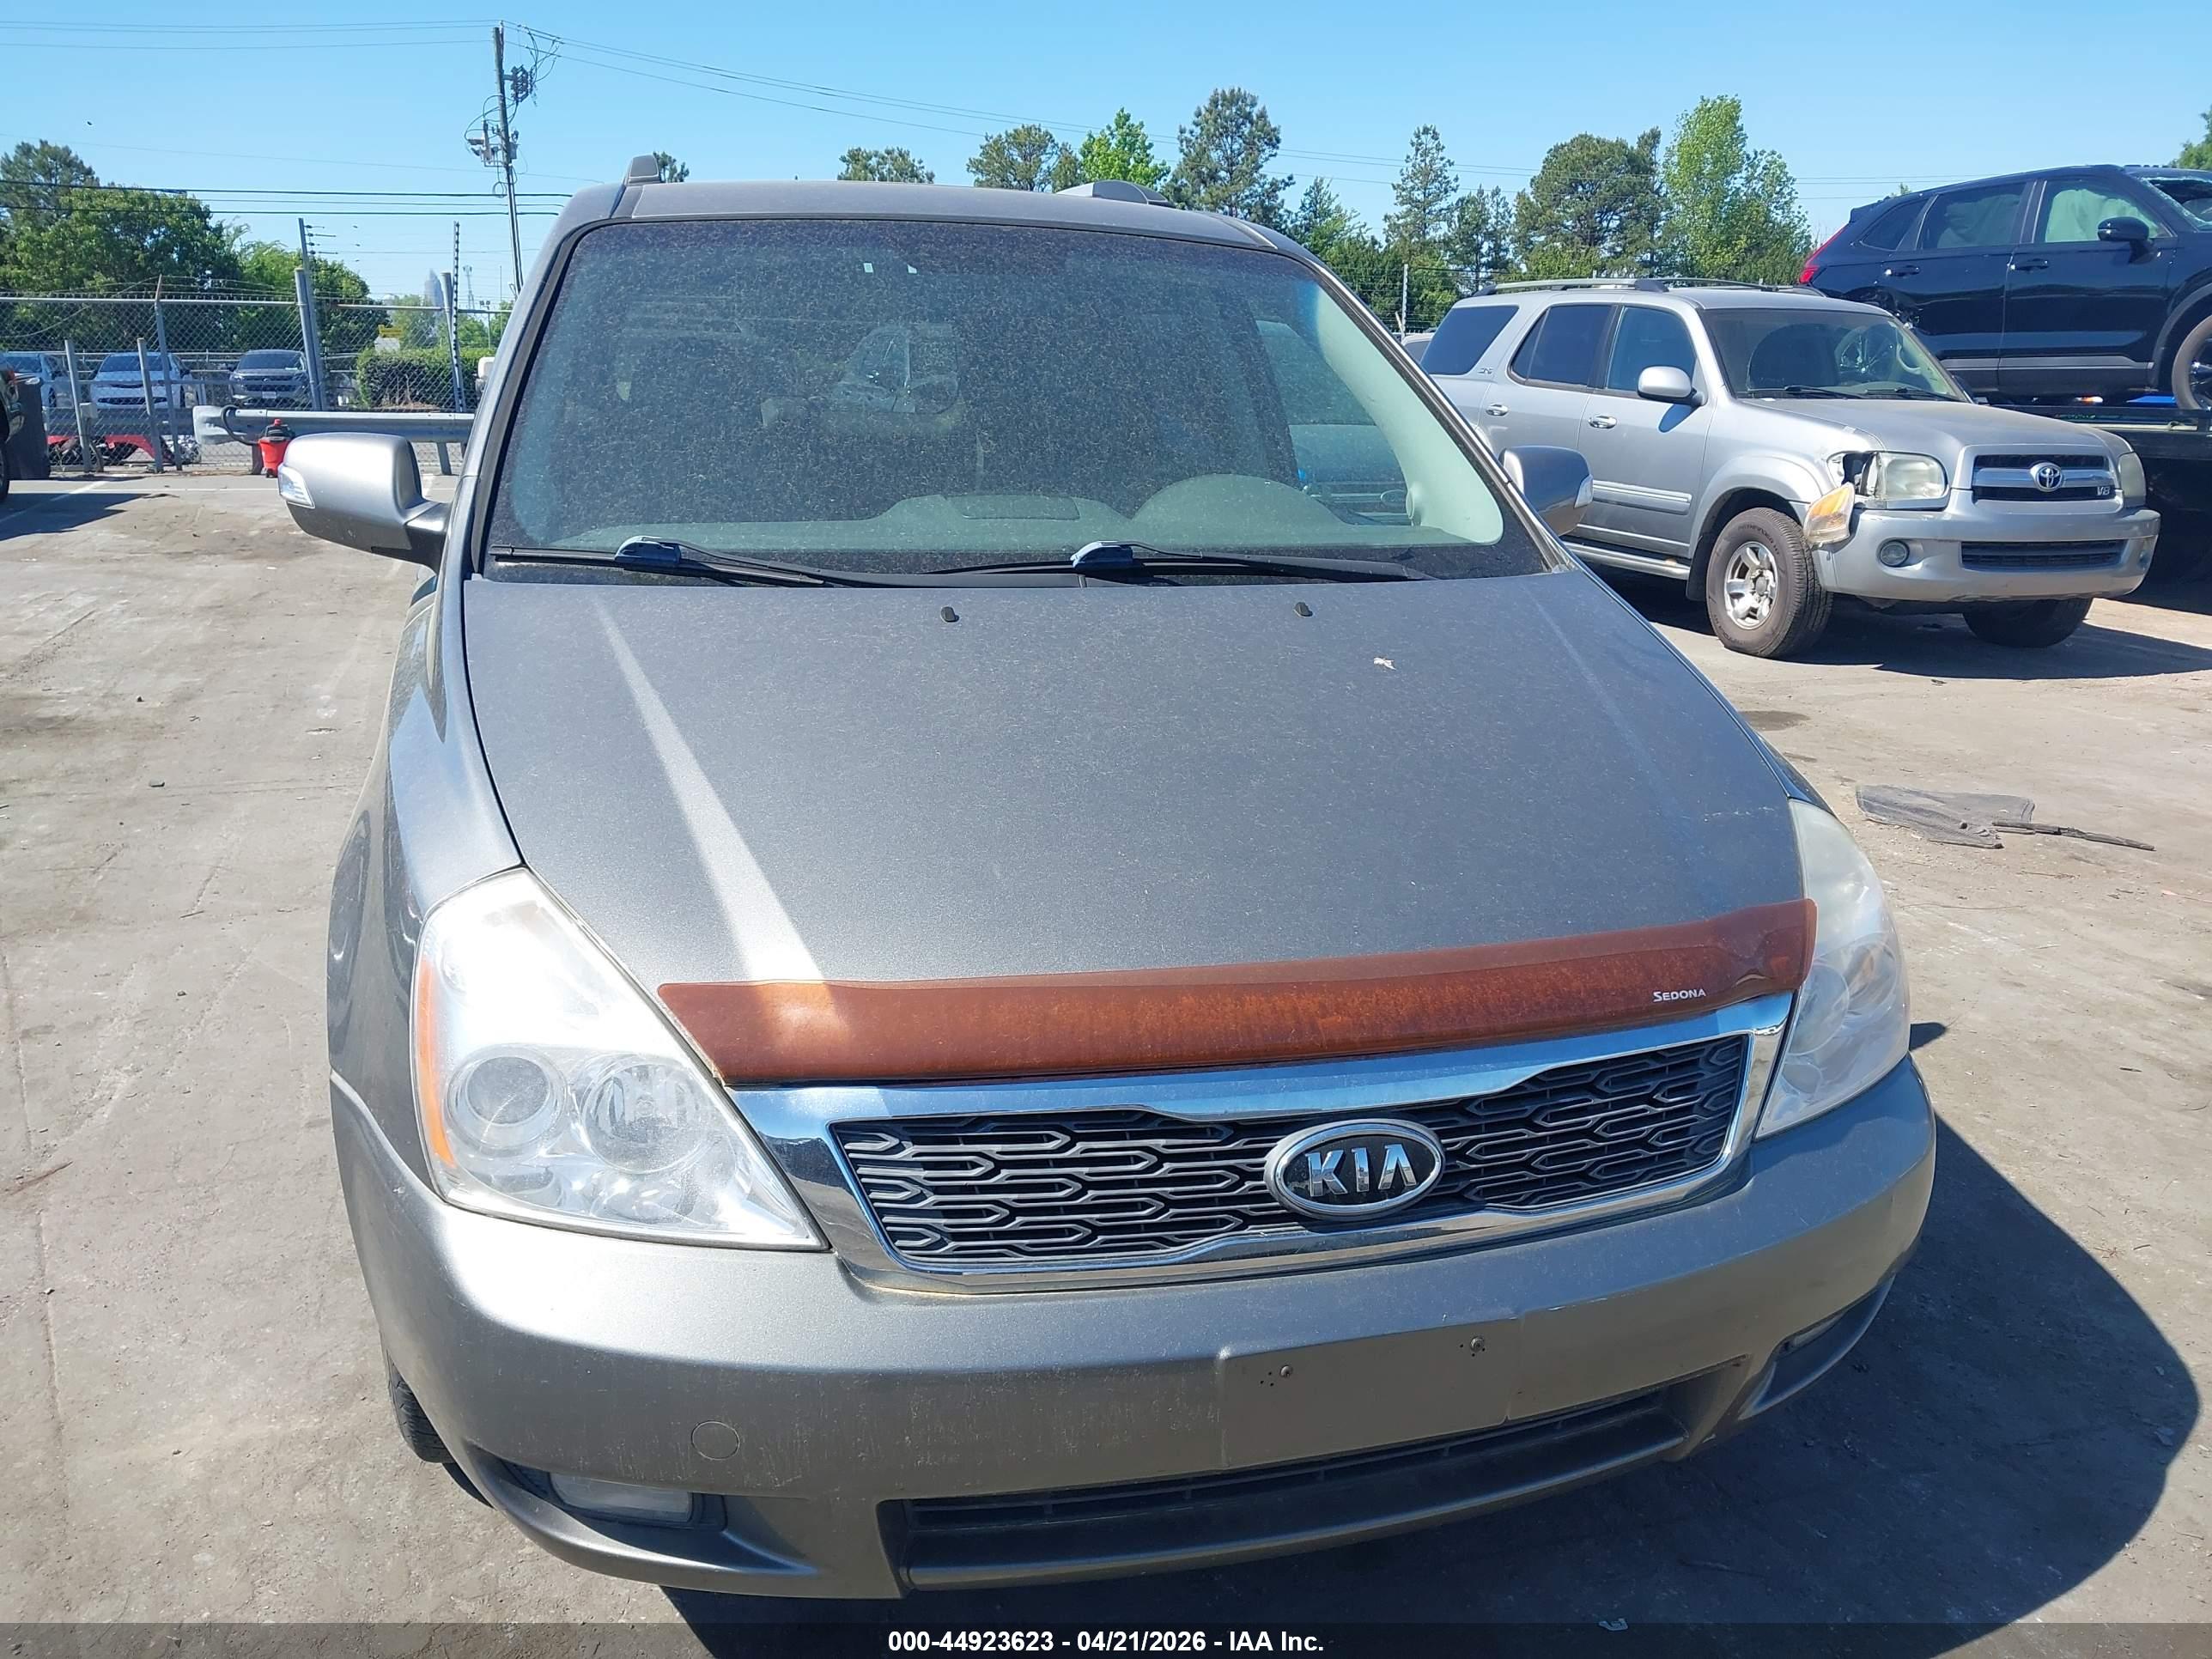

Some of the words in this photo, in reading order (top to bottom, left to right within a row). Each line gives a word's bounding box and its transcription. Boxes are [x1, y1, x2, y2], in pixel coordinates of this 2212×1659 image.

[2096, 486, 2111, 495] V8
[1652, 988, 1706, 1002] SEDONA
[1304, 1143, 1418, 1198] KIA
